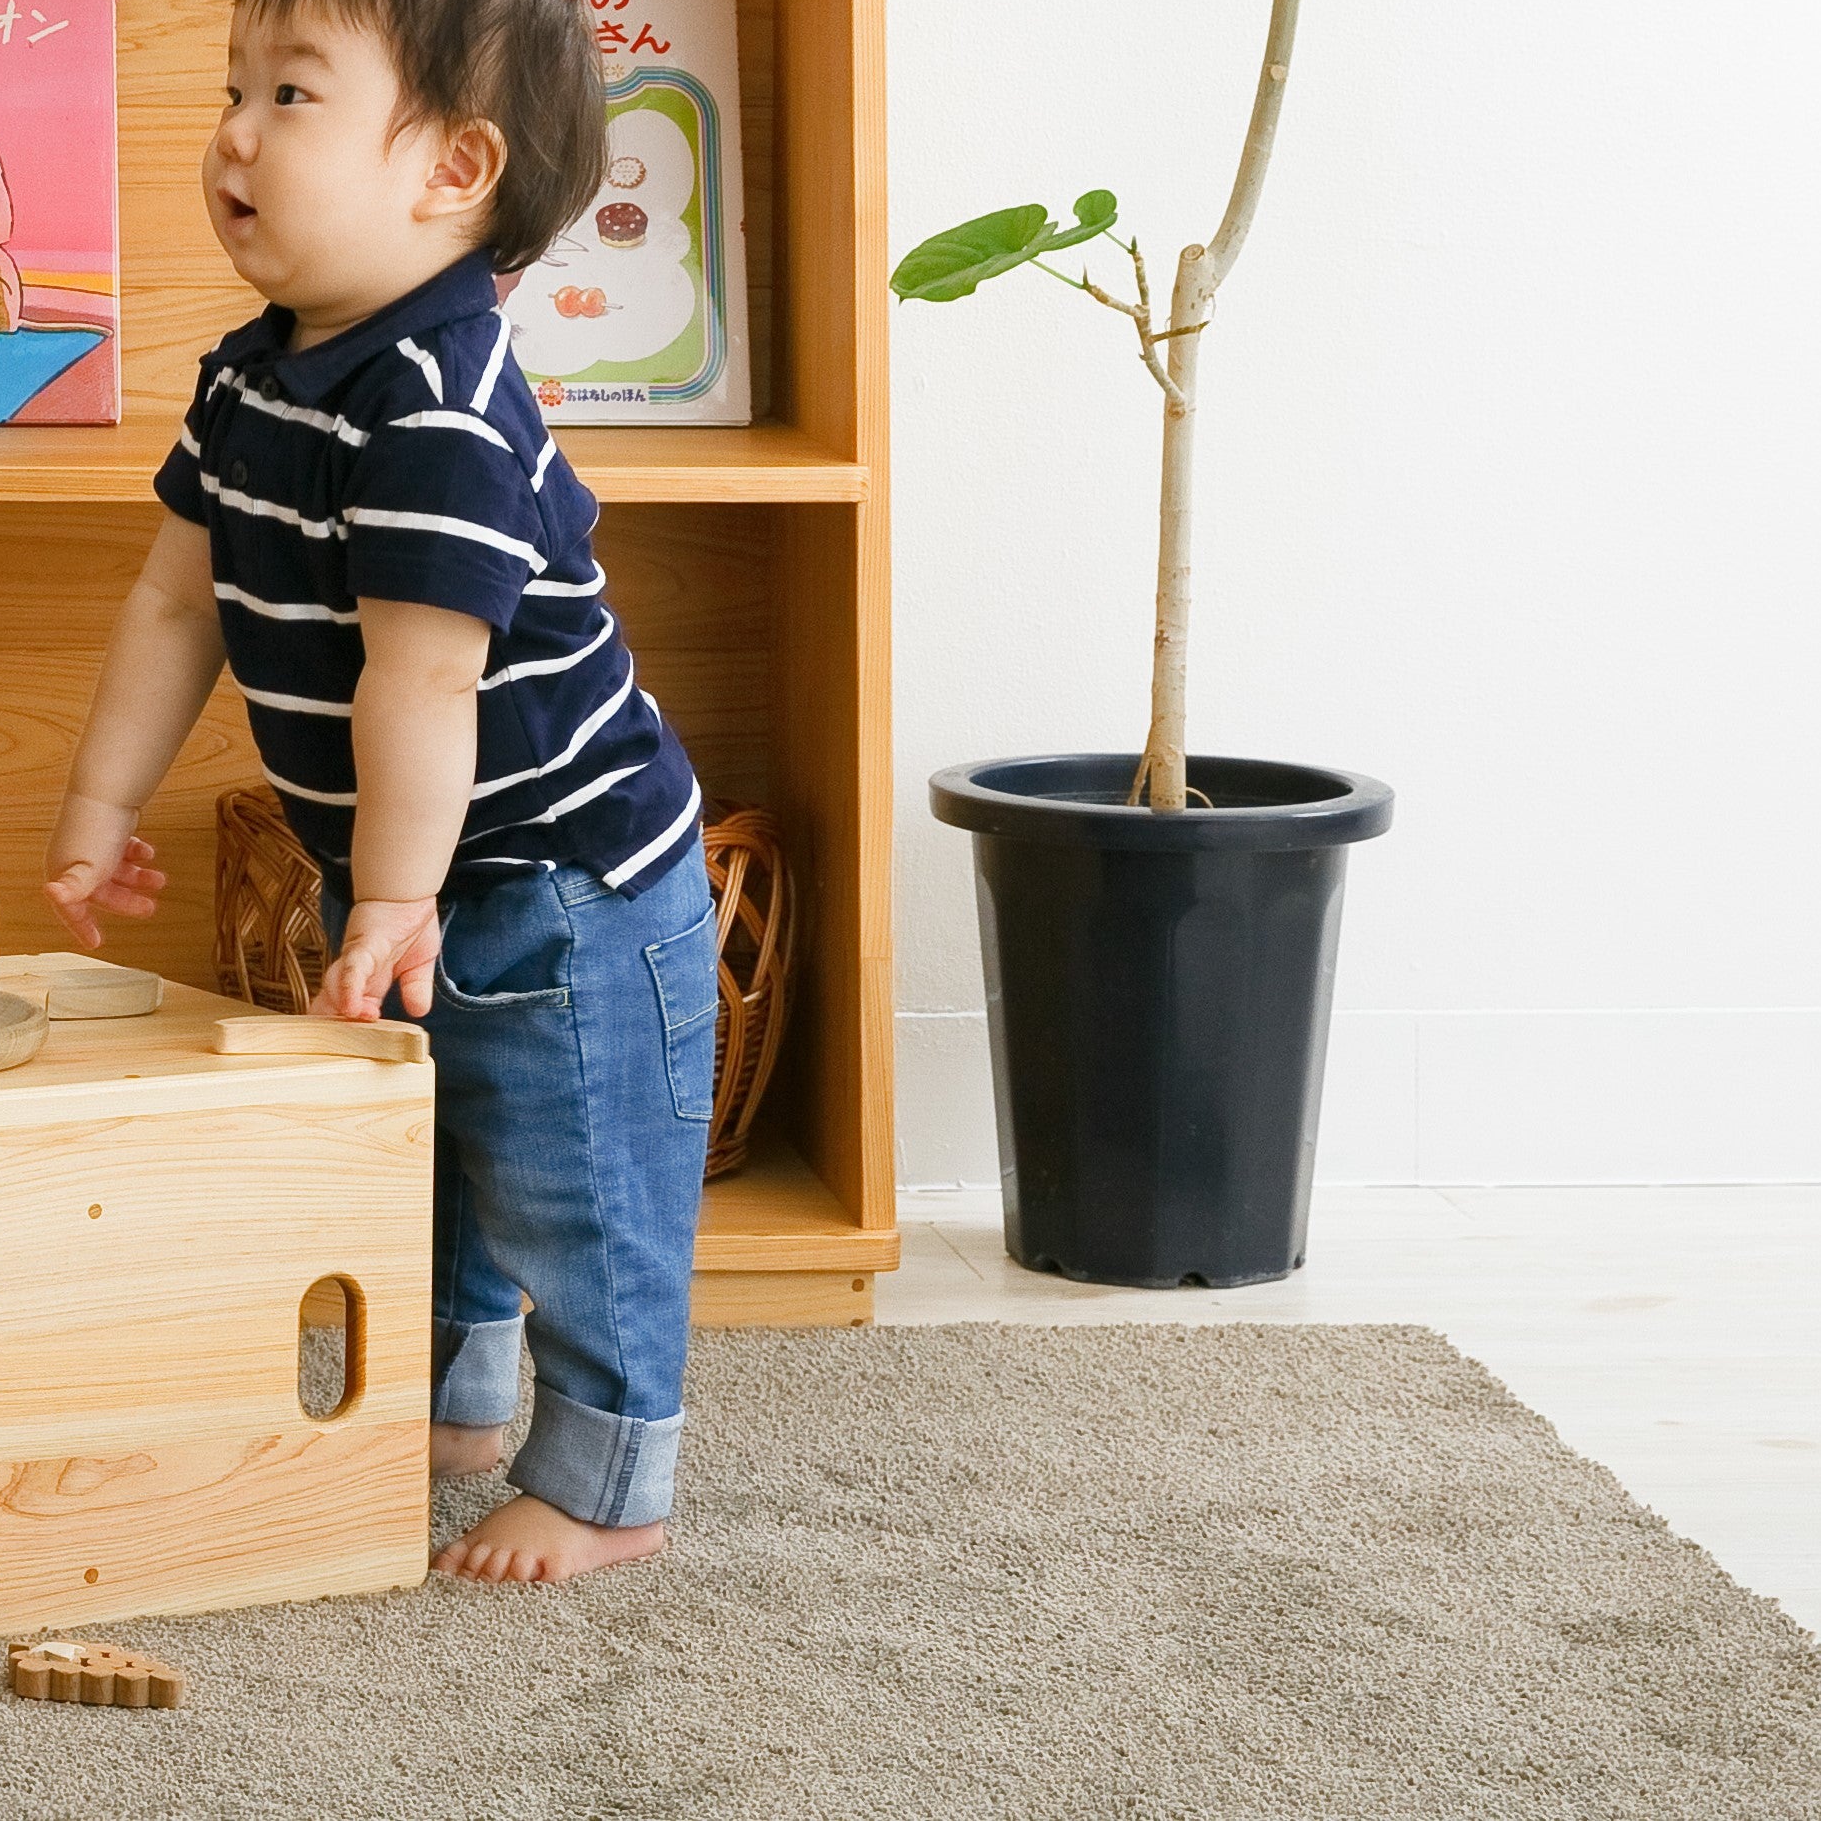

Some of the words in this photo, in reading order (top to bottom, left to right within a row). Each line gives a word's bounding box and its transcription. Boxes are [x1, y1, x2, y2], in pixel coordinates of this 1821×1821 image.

[565, 388, 647, 403] おはなしのほん
